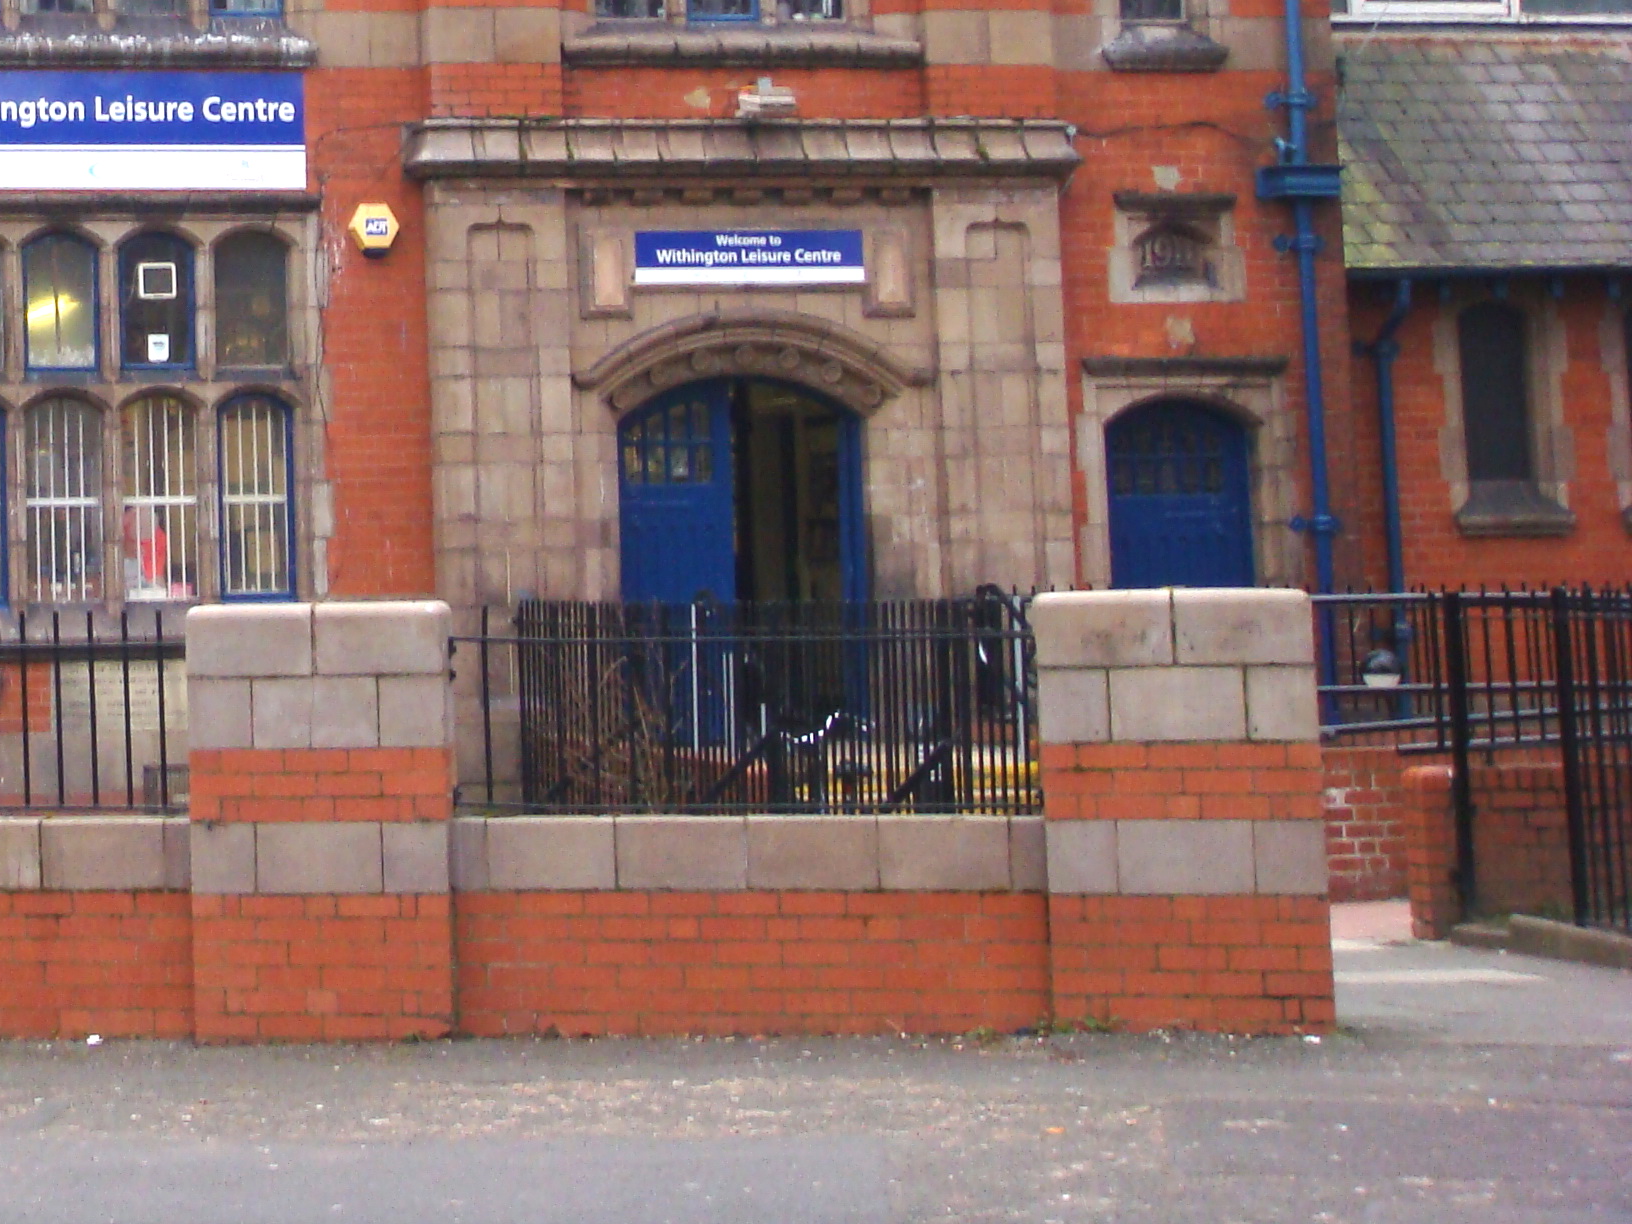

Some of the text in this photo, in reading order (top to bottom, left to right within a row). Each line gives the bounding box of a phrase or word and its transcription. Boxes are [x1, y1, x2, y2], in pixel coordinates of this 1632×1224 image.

[94, 94, 194, 122] Leisure
[202, 95, 295, 122] Centre
[716, 234, 782, 247] Welcome to
[656, 248, 842, 267] Withington Leisure Centre
